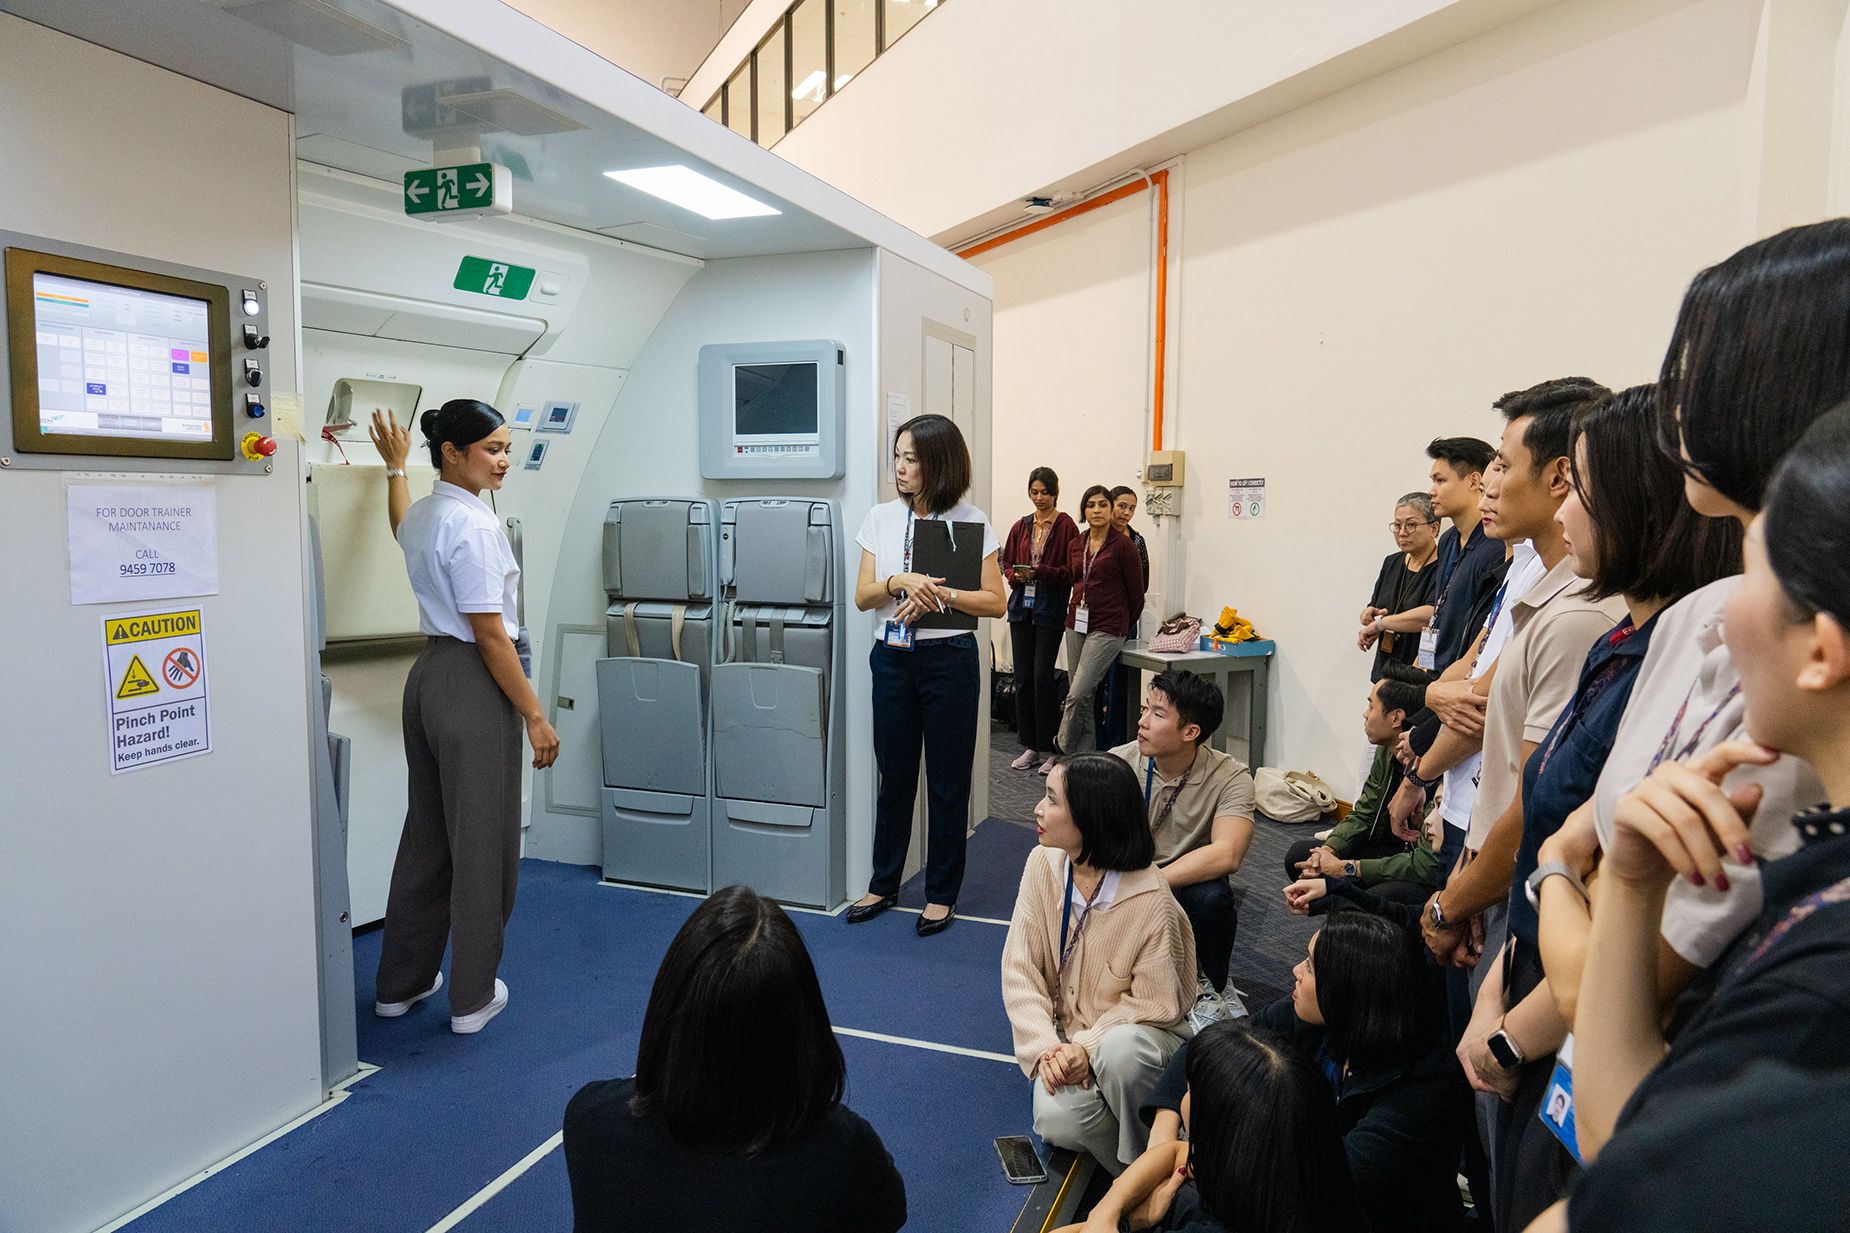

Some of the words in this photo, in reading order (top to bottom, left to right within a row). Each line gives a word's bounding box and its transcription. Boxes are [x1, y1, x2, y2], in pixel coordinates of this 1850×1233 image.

[96, 507, 117, 518] FOR
[119, 507, 149, 518] DOOR
[152, 507, 192, 517] TRAINER
[108, 521, 181, 532] MAINTANANCE
[135, 549, 159, 560] CALL
[119, 563, 147, 575] 9459
[149, 562, 176, 573] 7078
[129, 615, 196, 637] CAUTION
[116, 712, 156, 731] Pinch
[160, 704, 196, 722] Point
[117, 726, 170, 748] Hazard!
[118, 750, 143, 763] Keep
[144, 743, 173, 757] hands
[175, 738, 200, 751] clear.
